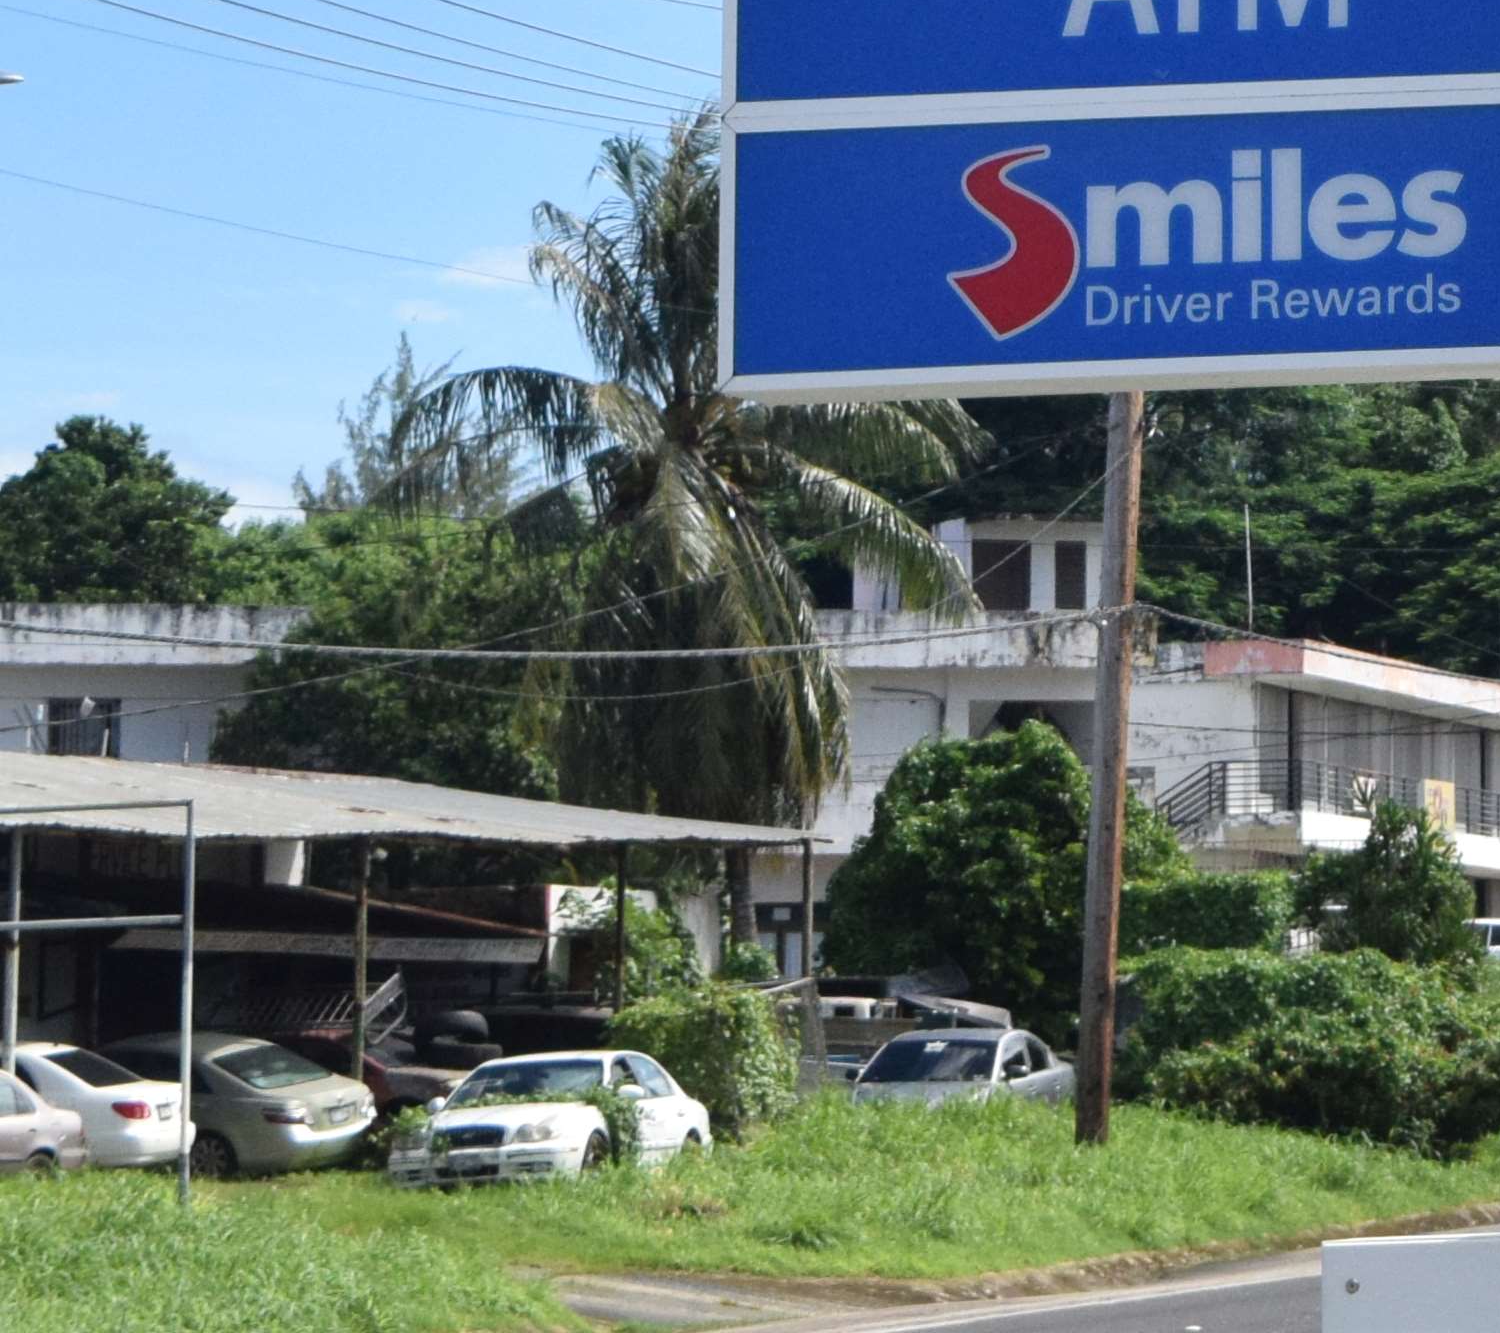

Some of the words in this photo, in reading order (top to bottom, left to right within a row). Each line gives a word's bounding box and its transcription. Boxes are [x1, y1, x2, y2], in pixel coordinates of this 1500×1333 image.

[946, 143, 1468, 341] Smiles
[1085, 284, 1234, 327] Driver
[1250, 271, 1462, 321] Rewards
